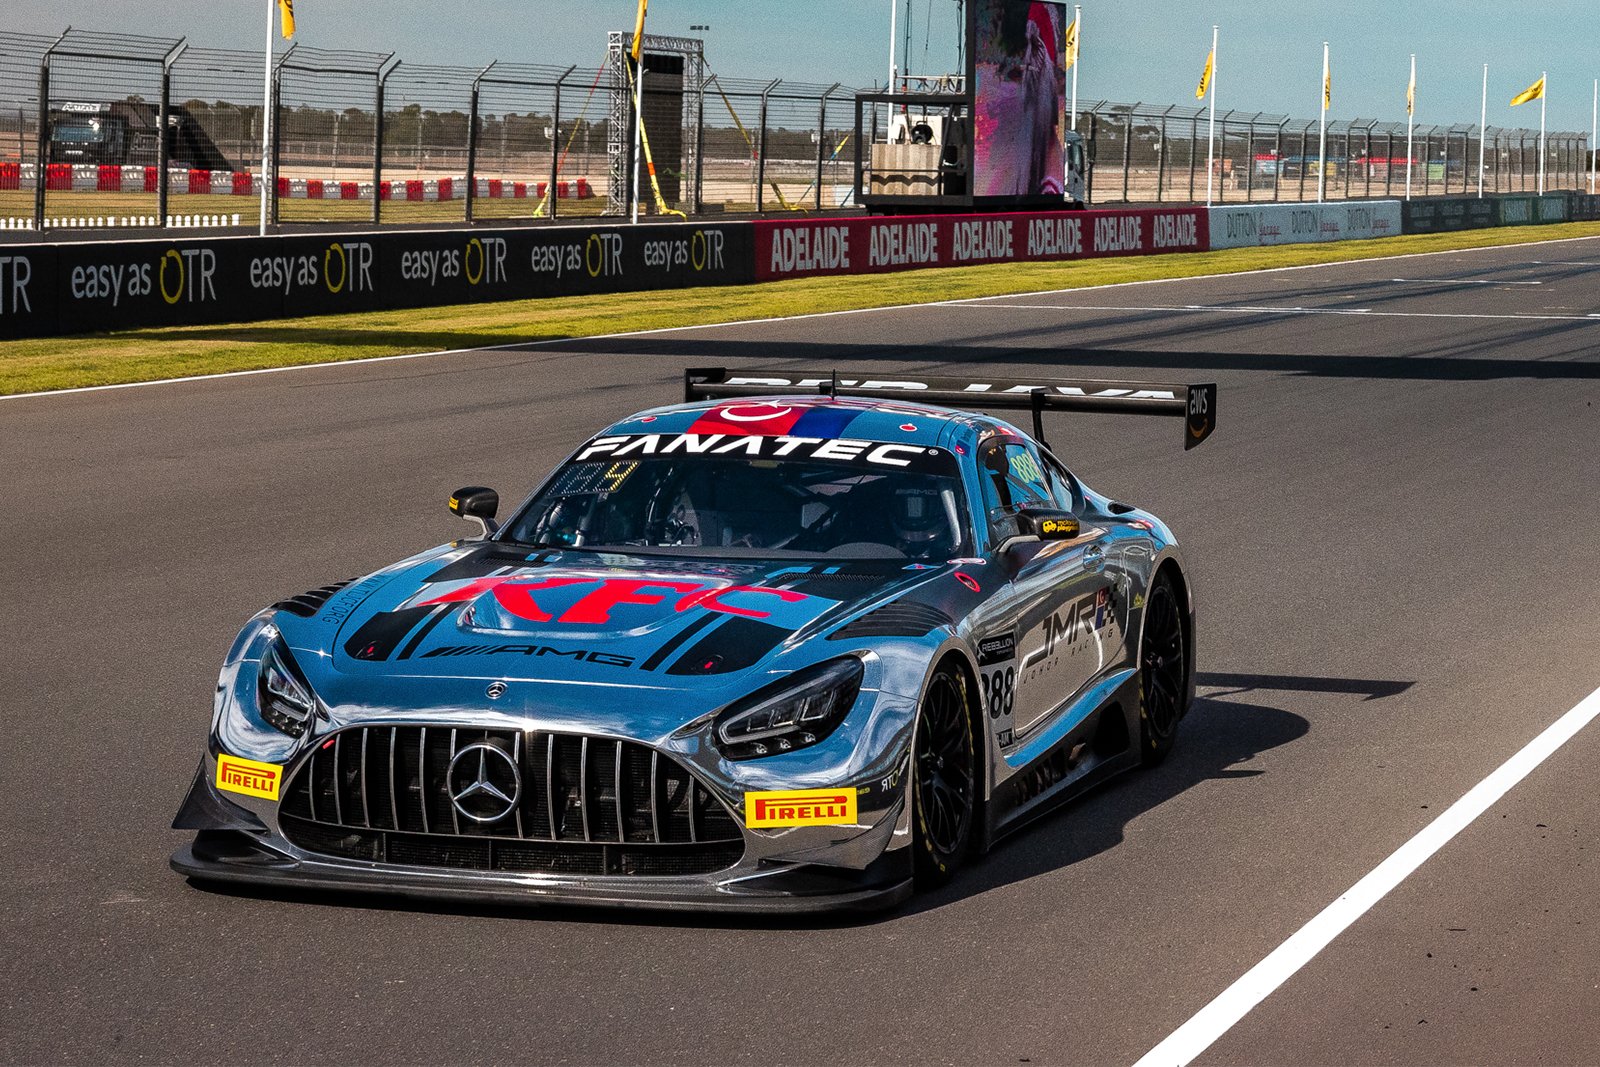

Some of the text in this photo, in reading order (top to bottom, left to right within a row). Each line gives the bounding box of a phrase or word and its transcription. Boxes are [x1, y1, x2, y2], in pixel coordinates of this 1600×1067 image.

[643, 229, 725, 272] easy as OTR
[771, 226, 850, 273] ADELAIDE
[868, 222, 938, 267] ADELAIDE
[952, 220, 1014, 261] ADELAIDE
[1027, 218, 1083, 256] ADELAIDE
[1093, 216, 1142, 252] ADELAIDE
[1152, 213, 1197, 248] ADELAIDE
[250, 242, 374, 296] easy as OTR
[401, 237, 508, 286] easy as OTR
[531, 233, 623, 279] easy as OTR
[71, 248, 216, 307] easy as OTR
[575, 433, 927, 467] FANATEC
[417, 576, 809, 625] KFC
[981, 638, 1013, 652] REBELLION
[221, 761, 276, 792] PIRELLI
[755, 795, 848, 821] PIRELLI
